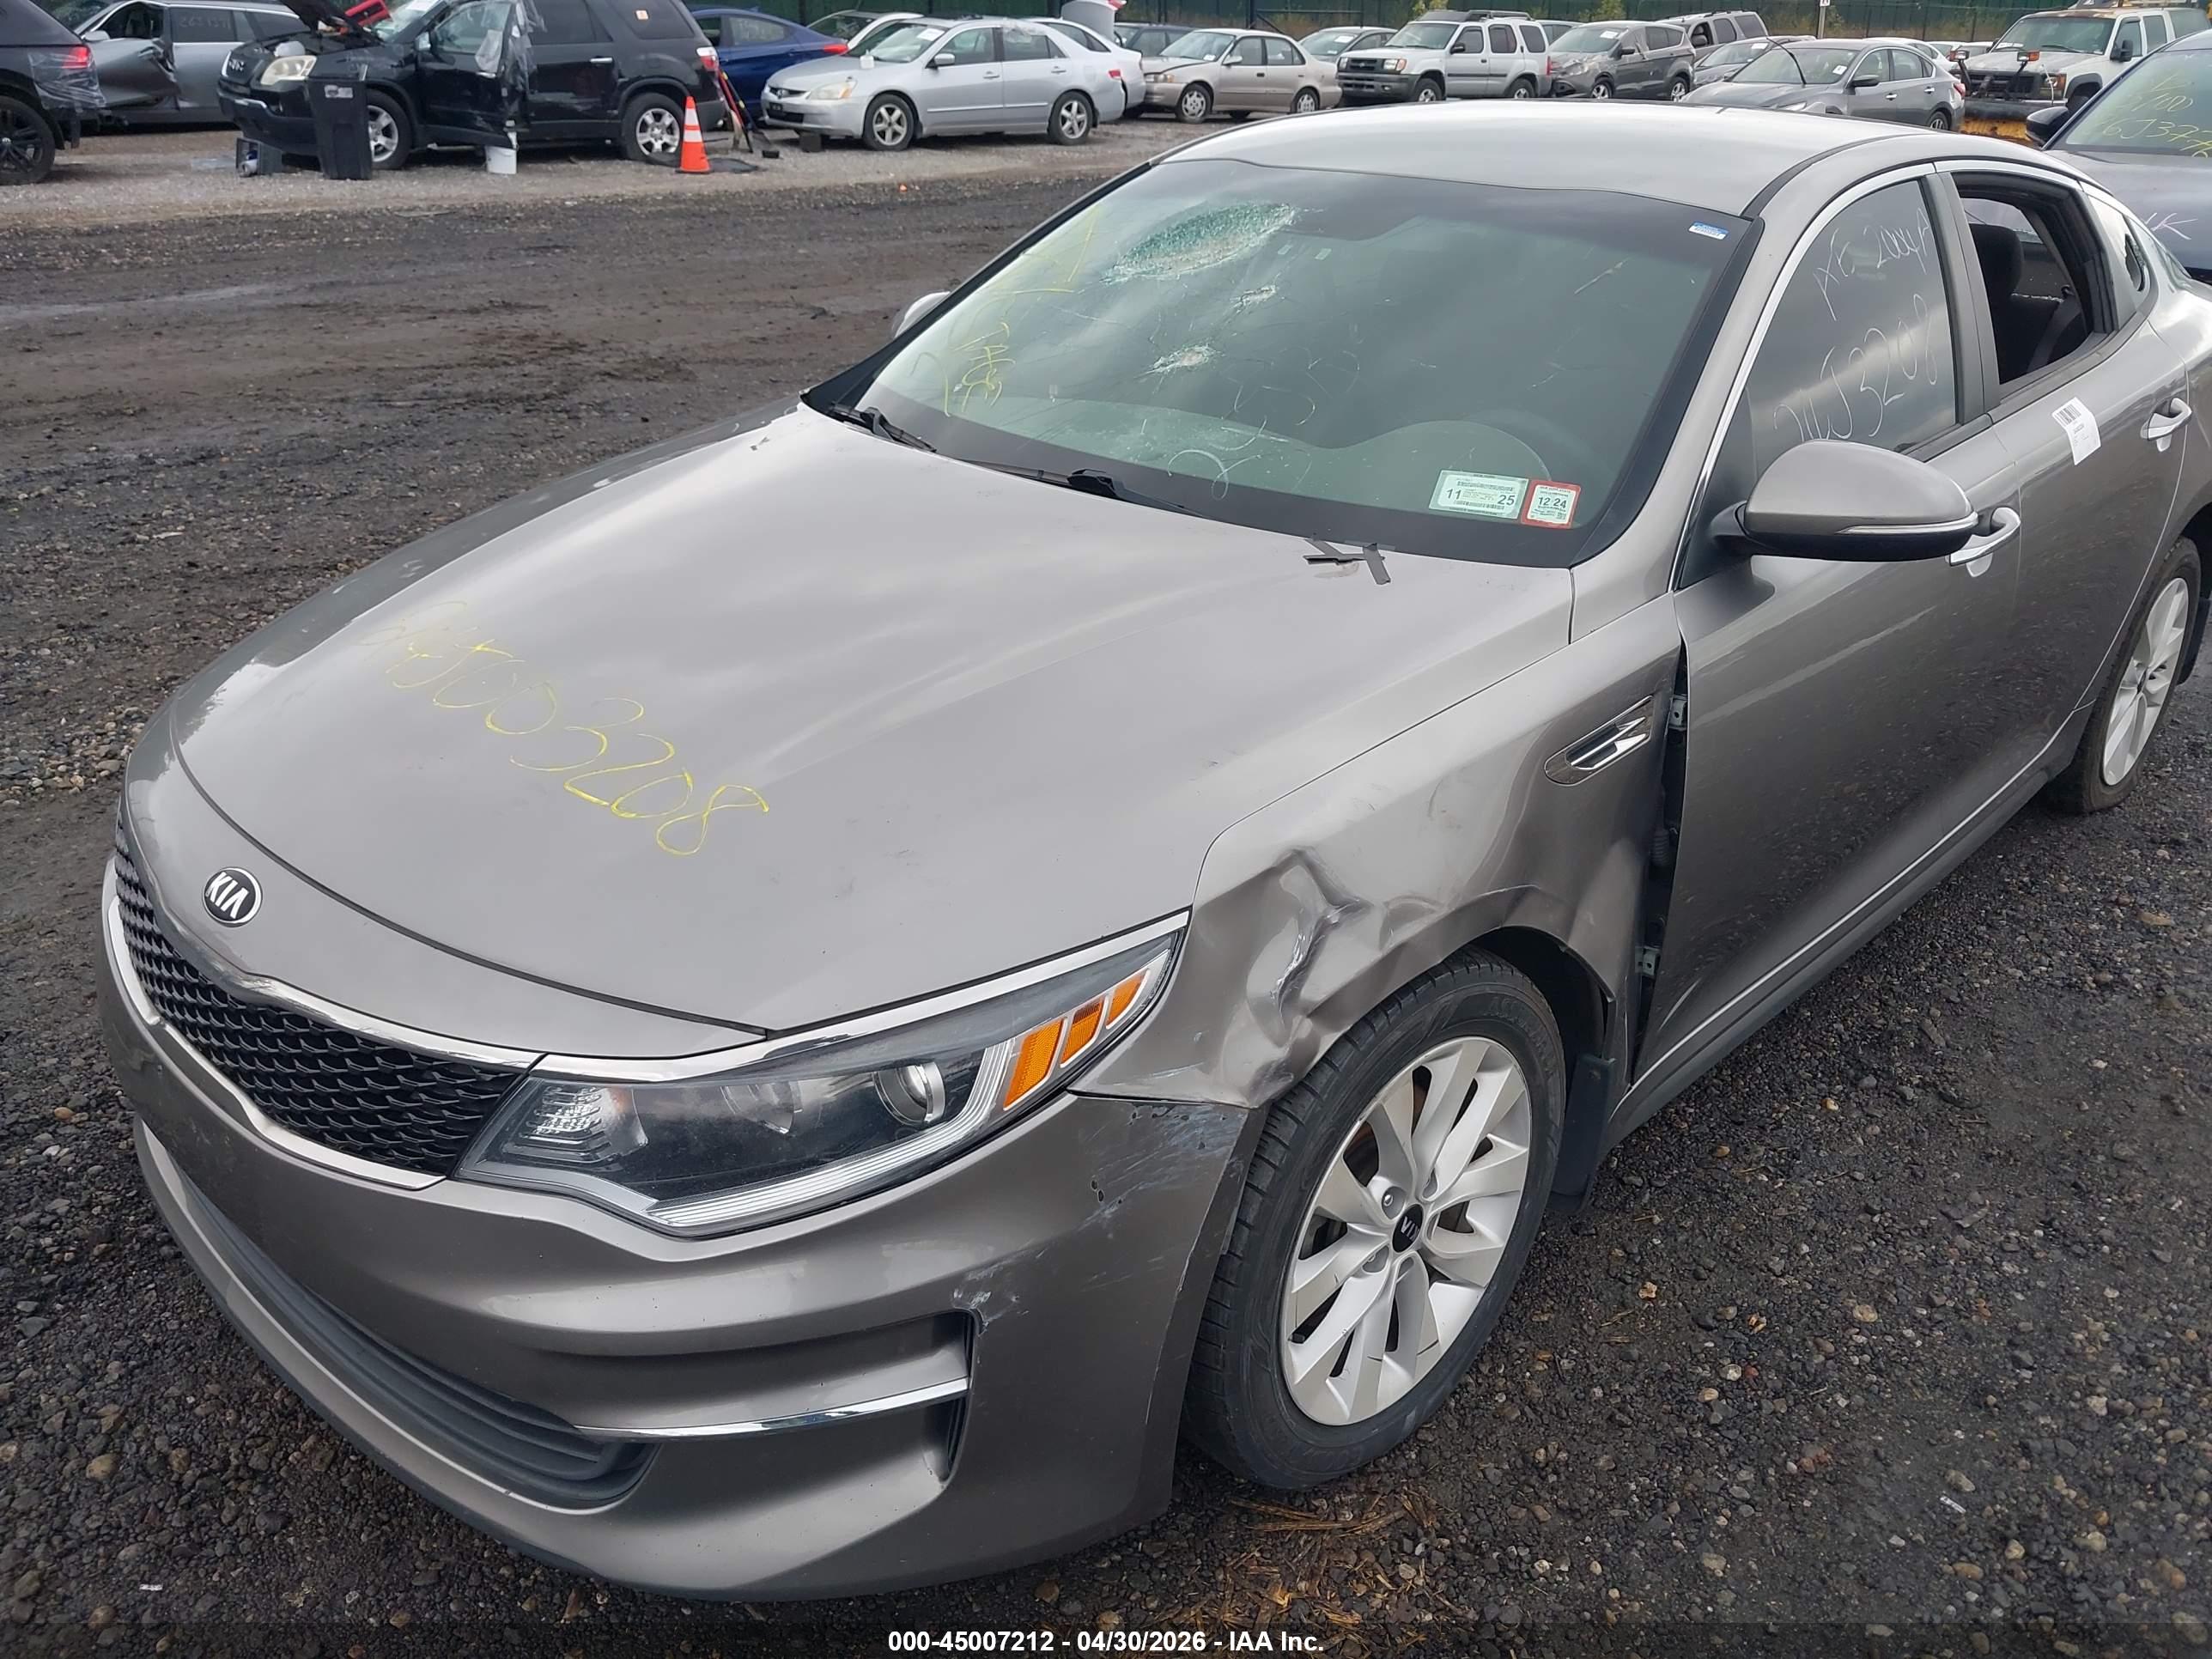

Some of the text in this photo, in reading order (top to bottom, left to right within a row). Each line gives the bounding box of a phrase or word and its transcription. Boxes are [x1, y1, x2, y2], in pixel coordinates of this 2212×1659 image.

[1446, 488, 1462, 500] 11
[1497, 494, 1516, 506] 25
[1538, 496, 1551, 506] 12
[1553, 497, 1567, 509] 24
[204, 871, 250, 920] KIA
